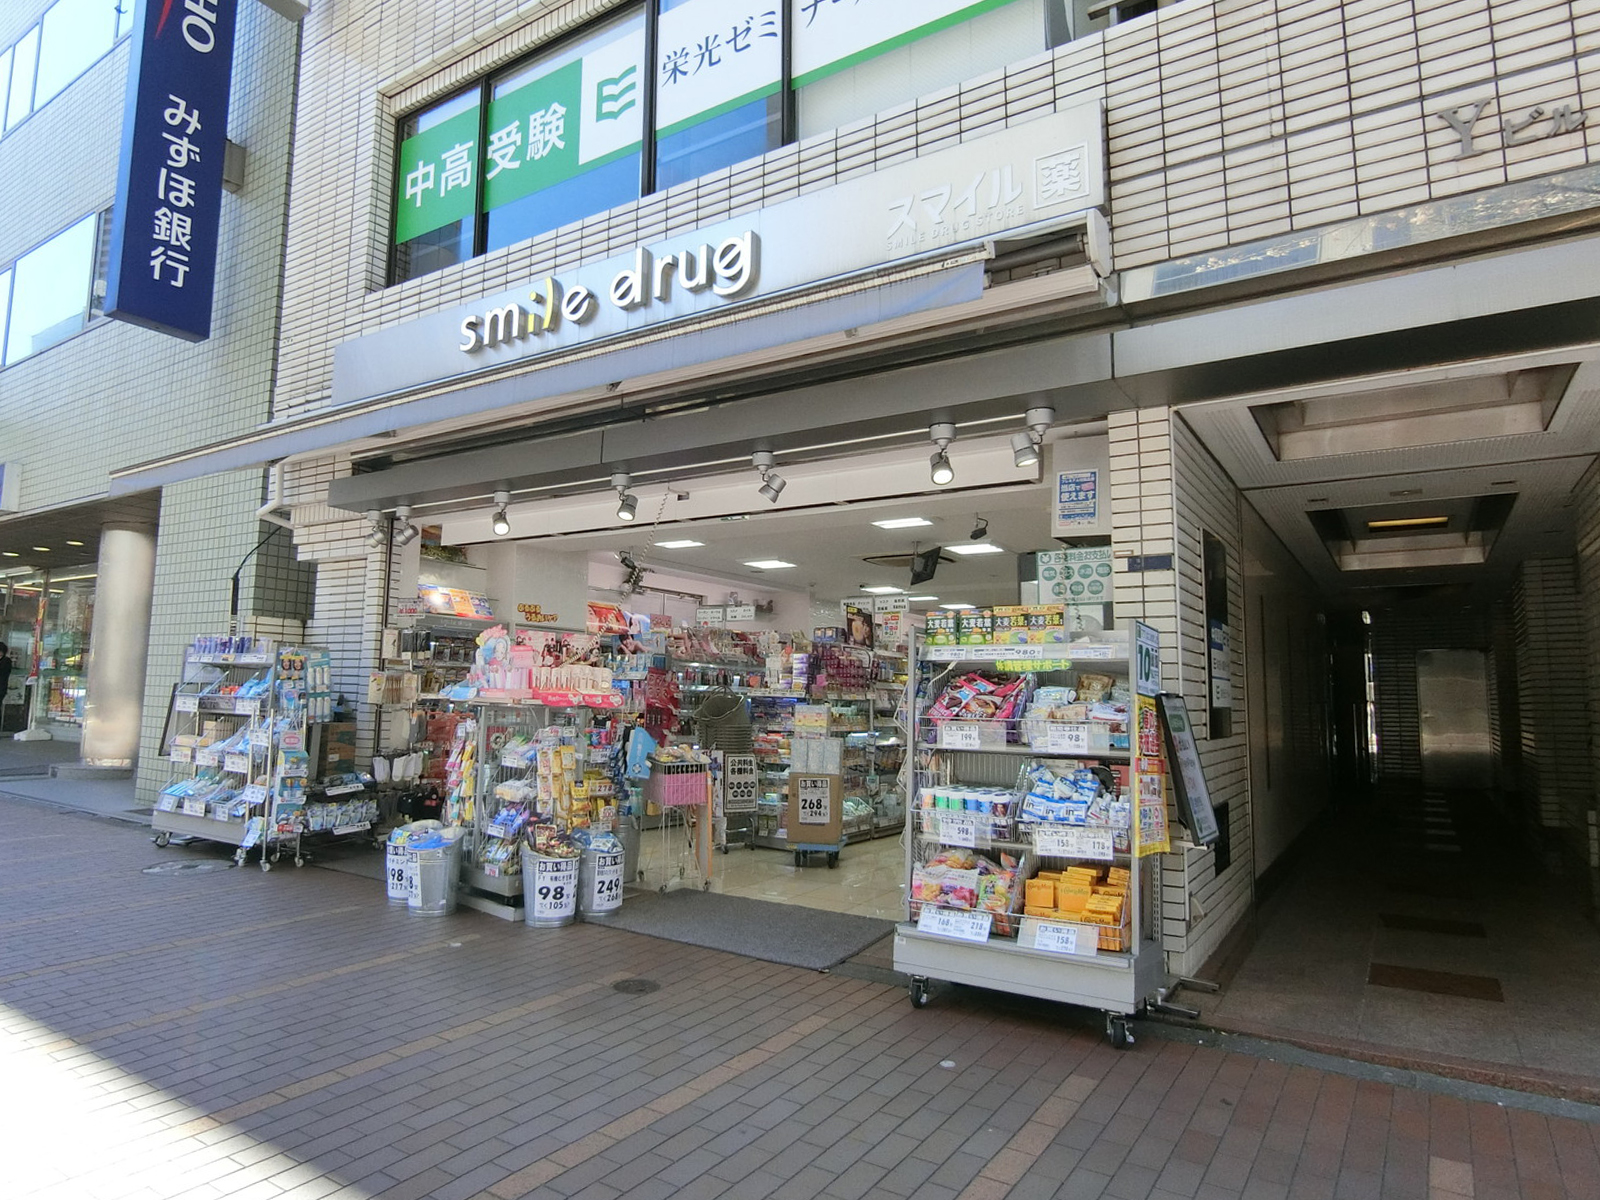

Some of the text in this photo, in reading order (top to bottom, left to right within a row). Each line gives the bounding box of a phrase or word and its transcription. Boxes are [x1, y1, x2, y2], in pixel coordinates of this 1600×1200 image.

[149, 94, 202, 288] みずほ銀行
[886, 152, 1081, 240] スマイル 薬
[886, 204, 1025, 252] SMILE DRUG STORE
[459, 231, 760, 353] smile drug
[1138, 644, 1151, 682] 10
[961, 733, 973, 741] 199
[1068, 734, 1080, 742] 98
[801, 798, 823, 810] 268
[538, 860, 573, 872] お買い得品
[538, 885, 564, 900] 98
[597, 878, 620, 894] 249
[549, 901, 564, 909] 105
